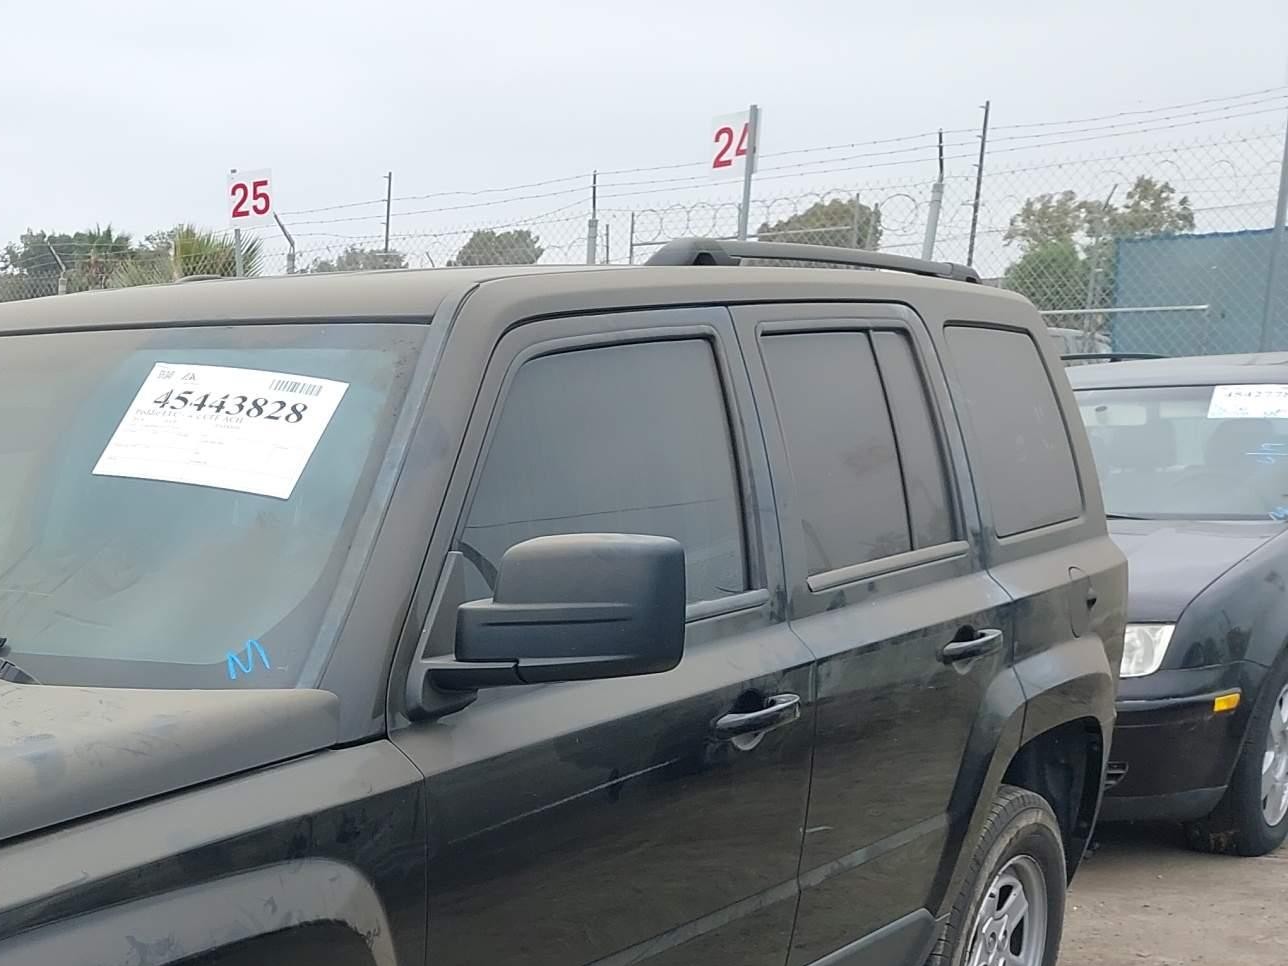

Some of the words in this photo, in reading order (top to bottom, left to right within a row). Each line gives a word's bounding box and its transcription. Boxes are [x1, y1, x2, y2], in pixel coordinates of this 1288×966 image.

[231, 180, 270, 218] 25
[153, 389, 308, 423] 45443828
[226, 639, 271, 680] M
